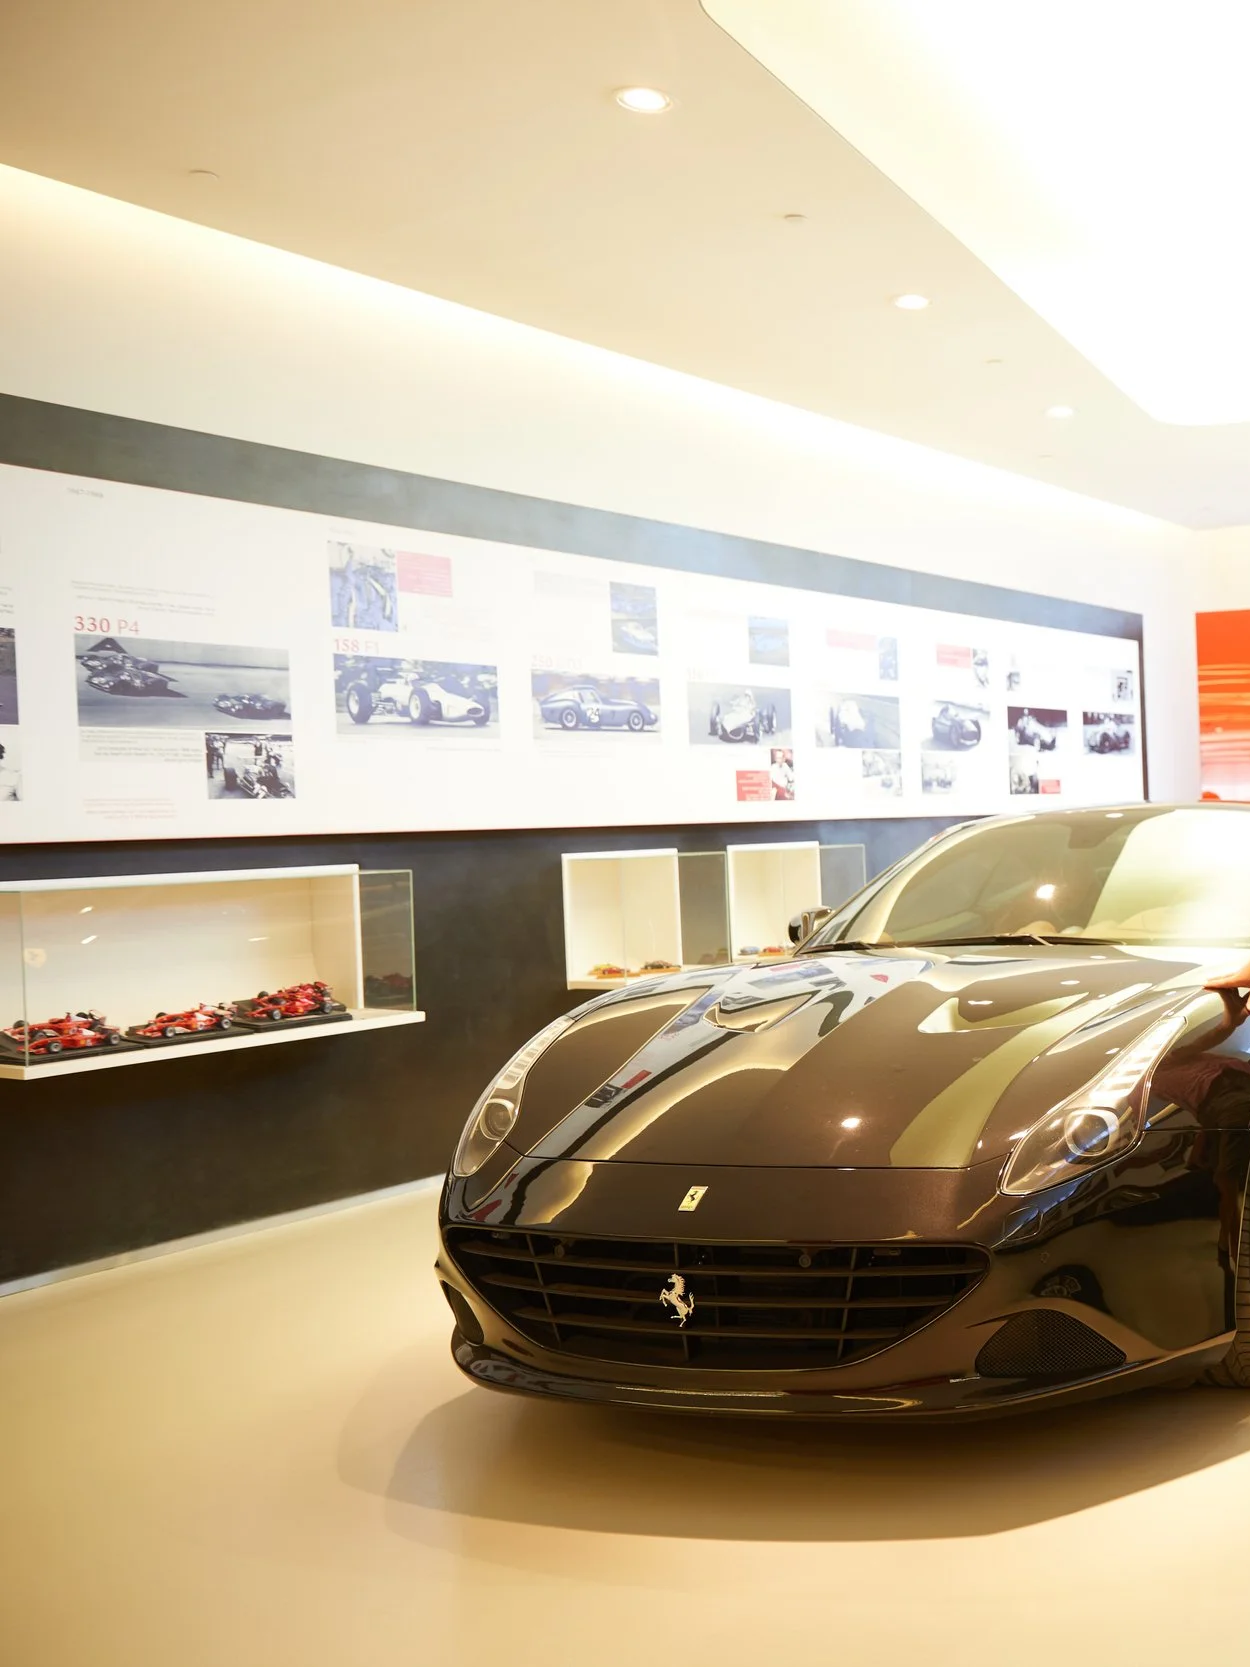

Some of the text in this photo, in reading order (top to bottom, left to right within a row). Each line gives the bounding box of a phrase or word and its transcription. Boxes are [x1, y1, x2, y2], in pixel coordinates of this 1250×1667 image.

[74, 615, 141, 635] 330 P4
[334, 638, 360, 653] 158
